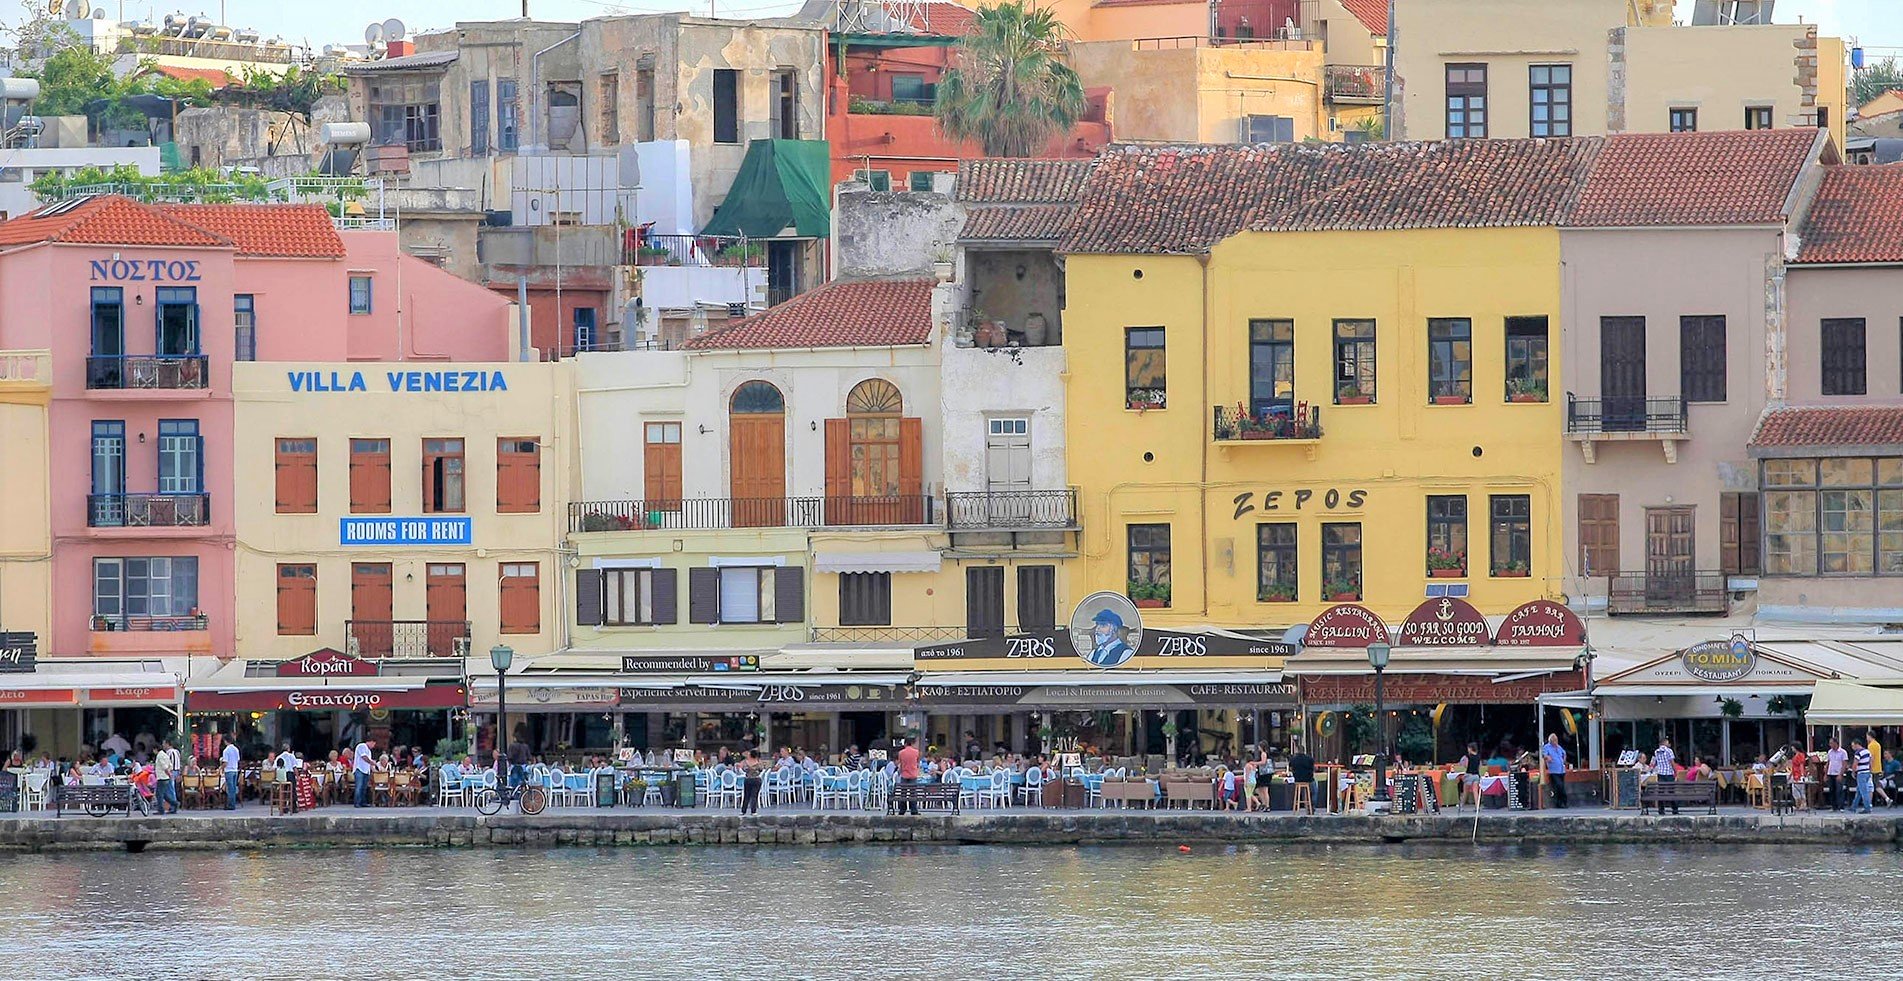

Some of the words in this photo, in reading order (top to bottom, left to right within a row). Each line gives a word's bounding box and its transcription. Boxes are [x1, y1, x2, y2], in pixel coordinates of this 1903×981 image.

[89, 260, 201, 281] ΝΟΣΤΟΣ
[288, 372, 367, 392] VILLA
[387, 372, 507, 392] VENEZIA
[1233, 488, 1368, 521] ZEPOS
[347, 522, 396, 540] ROOMS
[402, 522, 427, 540] FOR
[432, 522, 466, 539] RENT
[1512, 605, 1538, 622] CAFE
[1544, 606, 1565, 623] BAR
[1309, 613, 1333, 639] MUSIC
[1335, 607, 1385, 640] RESTAURANT
[1405, 622, 1417, 635] SO
[1420, 622, 1442, 636] FAR
[1442, 622, 1455, 634] SO
[1456, 621, 1484, 637] GOOD
[1321, 626, 1370, 640] GALLINI
[1411, 636, 1477, 644] WELCOME
[920, 649, 934, 657] από
[946, 647, 965, 656] 1961
[1005, 637, 1055, 658] ZEPOS
[1157, 636, 1207, 656] ZEPOS
[1249, 644, 1269, 654] since
[1271, 645, 1289, 654] 1961
[626, 658, 696, 670] Recommended
[698, 658, 711, 671] by
[1693, 667, 1742, 680] RESTAURANT
[620, 687, 673, 699] Experience
[674, 687, 706, 697] served
[720, 688, 727, 697] a
[757, 684, 804, 702] ZEPOS
[826, 692, 841, 700] 1961
[922, 687, 951, 697] ΚΑΦΕ
[958, 687, 1022, 696] ΕΣΤΙΑΤΟΡΙΟ
[1046, 688, 1068, 696] Local
[1070, 688, 1078, 696] &
[1080, 688, 1132, 696] International
[1134, 688, 1166, 696] Cuisine
[1191, 685, 1217, 695] CAFE
[1224, 684, 1293, 695] RESTAURANT
[1308, 687, 1416, 699] RESTAURANT
[1427, 686, 1482, 699] MUSIC
[1492, 686, 1533, 699] CAFE
[288, 692, 381, 706] Εστιατόριο
